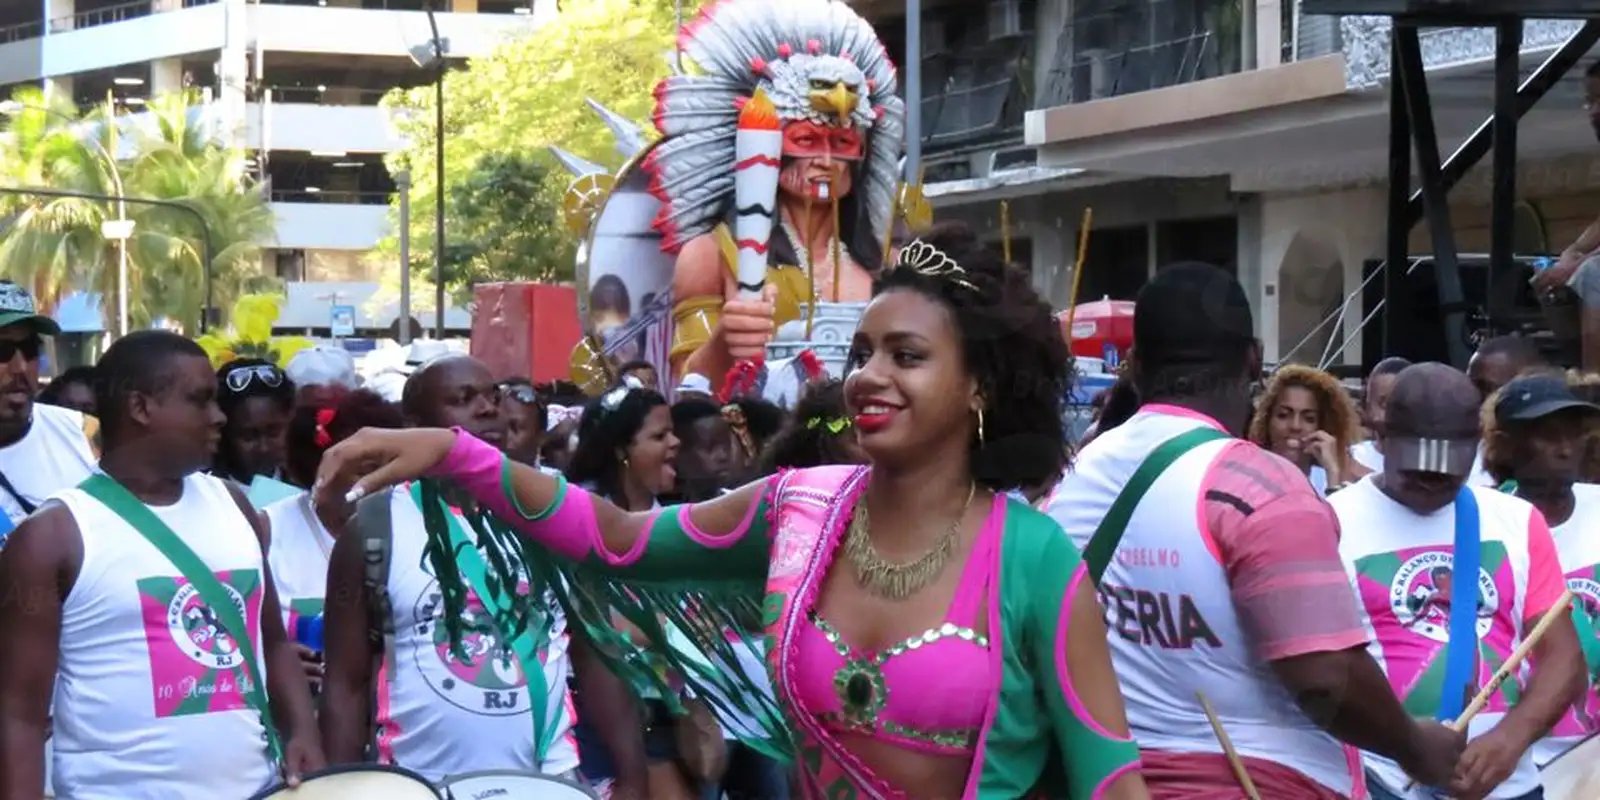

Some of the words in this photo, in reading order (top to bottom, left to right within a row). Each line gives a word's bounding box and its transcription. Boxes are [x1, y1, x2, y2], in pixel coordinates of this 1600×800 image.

[1097, 582, 1224, 649] TERIA
[216, 655, 233, 666] RJ
[482, 691, 519, 709] RJ
